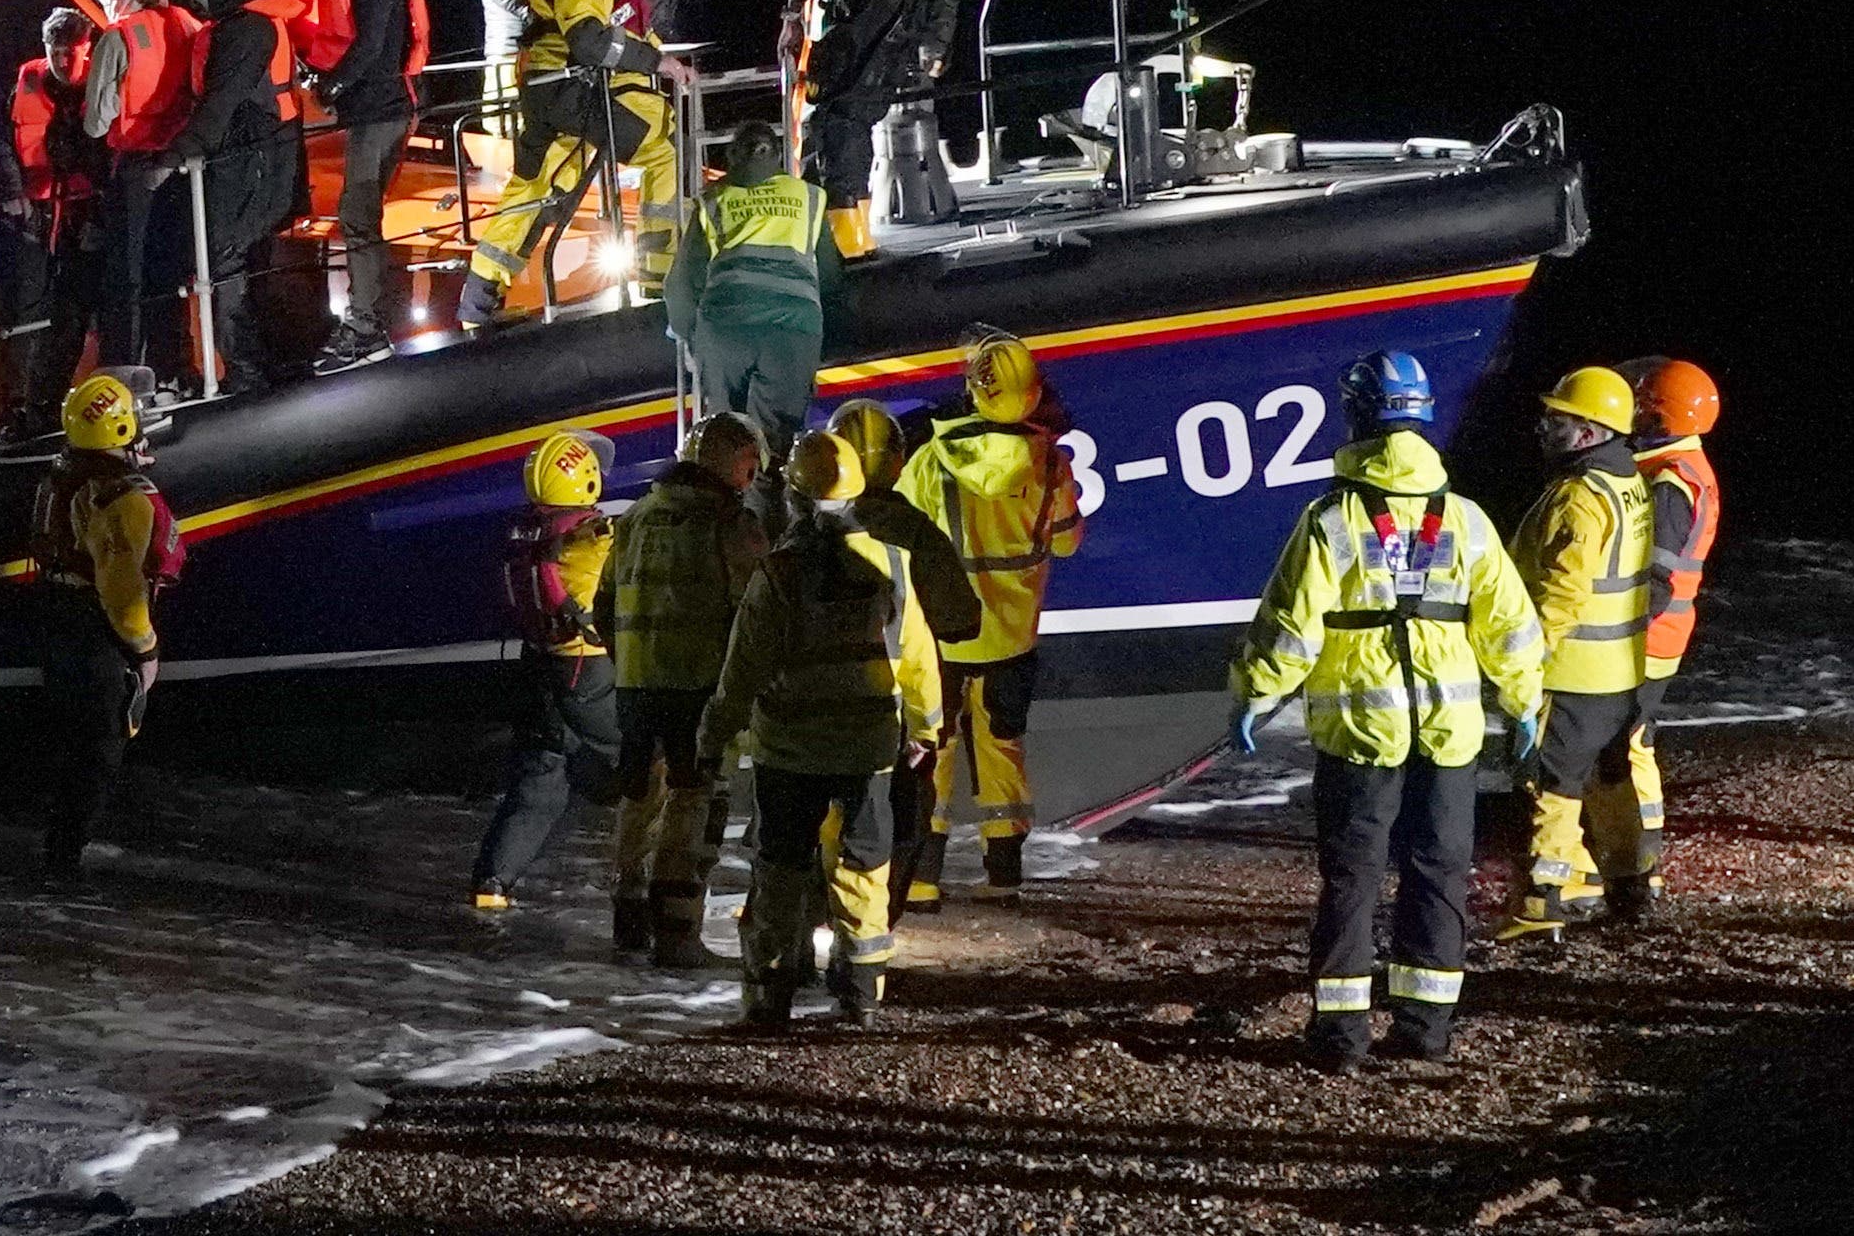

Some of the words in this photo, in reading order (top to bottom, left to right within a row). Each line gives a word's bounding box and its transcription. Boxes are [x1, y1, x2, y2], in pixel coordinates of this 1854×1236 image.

[726, 195, 803, 211] REGISTERED
[730, 206, 802, 222] PARAMEDIC
[81, 385, 121, 425] RNLI
